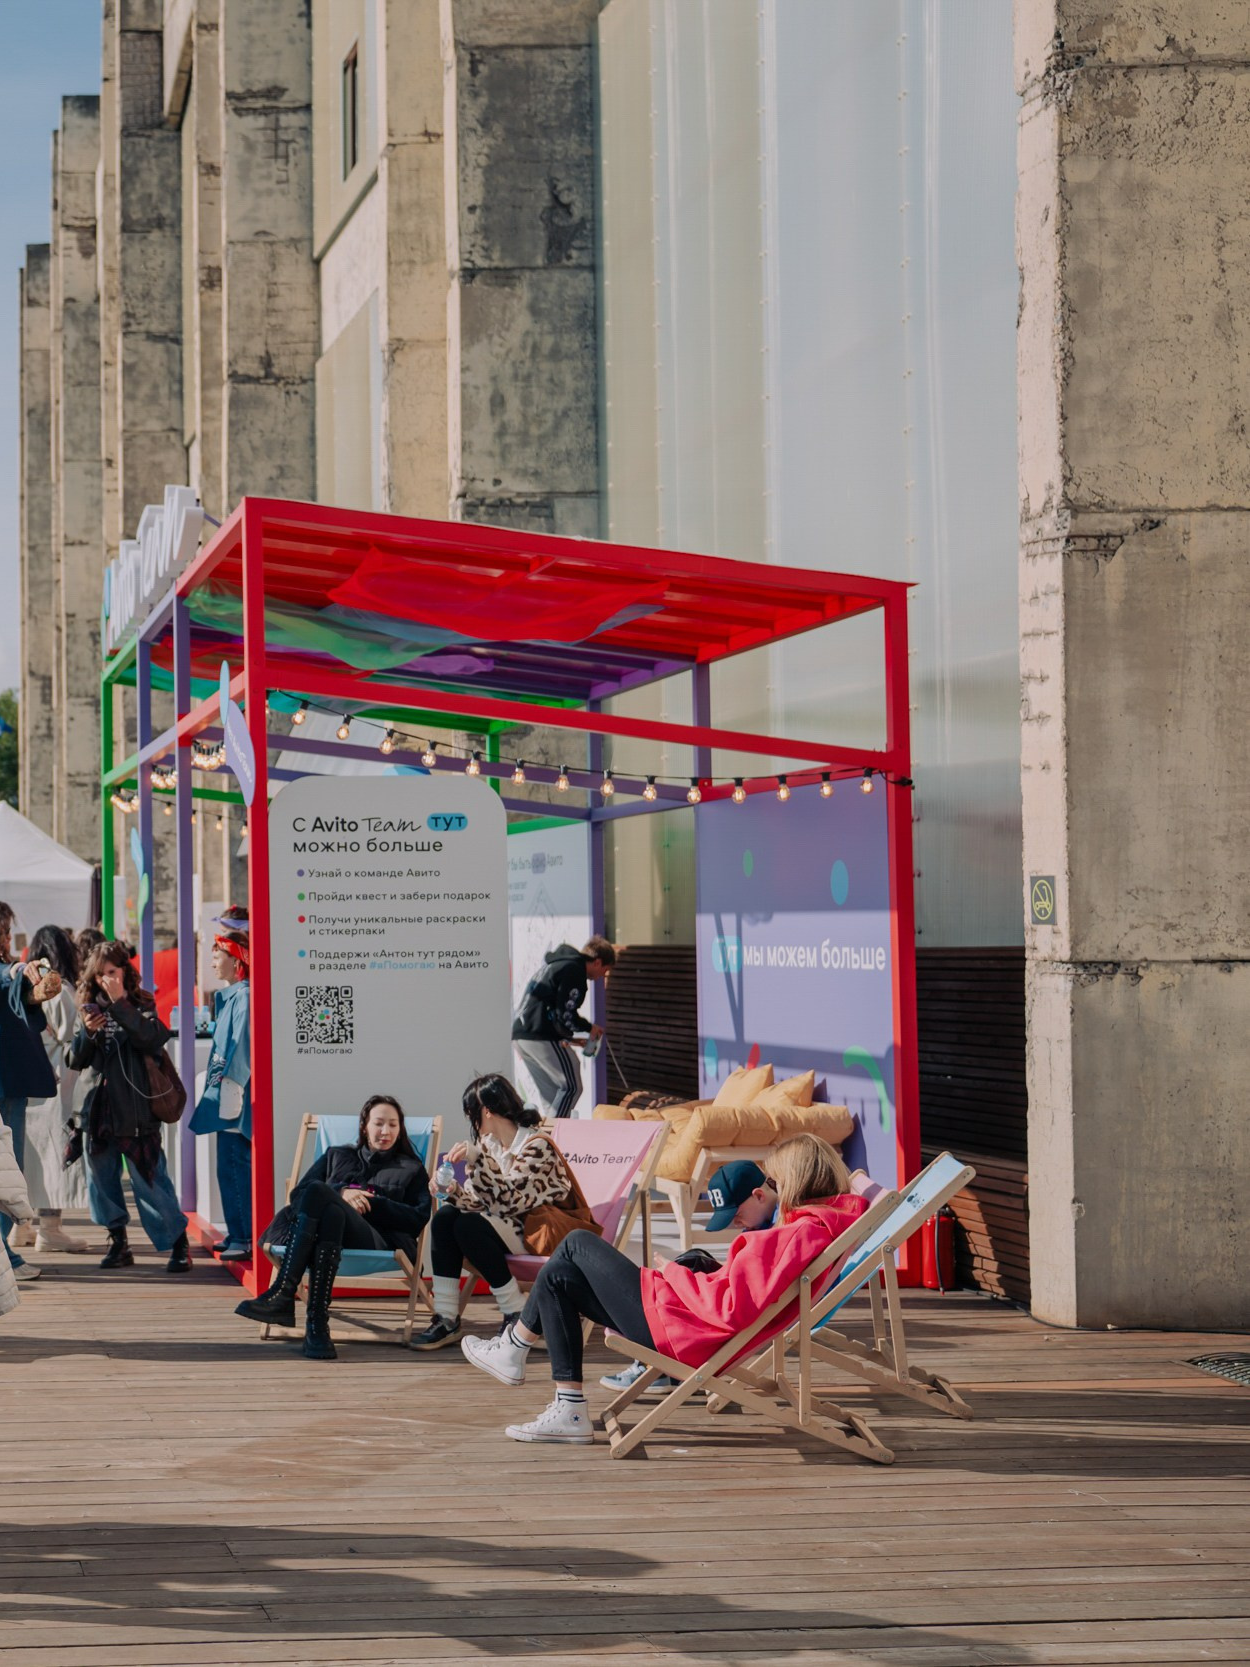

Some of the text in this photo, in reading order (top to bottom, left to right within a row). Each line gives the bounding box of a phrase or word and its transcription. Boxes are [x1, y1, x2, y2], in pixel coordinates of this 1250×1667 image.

[311, 815, 359, 833] Avito
[361, 816, 422, 833] Team
[430, 815, 466, 831] тут
[293, 837, 444, 853] можно больше
[308, 867, 441, 879] Узнай о команде Авито
[308, 891, 491, 903] Пройди квест и забери подарок
[308, 914, 486, 926] Получи уникальные раскраски
[309, 927, 386, 937] и стикерпаки
[309, 949, 481, 961] Поддержи «Антон тут рядом»
[743, 945, 764, 967] мы
[767, 945, 818, 968] можем
[821, 938, 886, 970] больше
[309, 959, 490, 972] в разделе #яПомогаю на Авито
[297, 1047, 353, 1055] #яПомогаю
[569, 1153, 599, 1164] Avito
